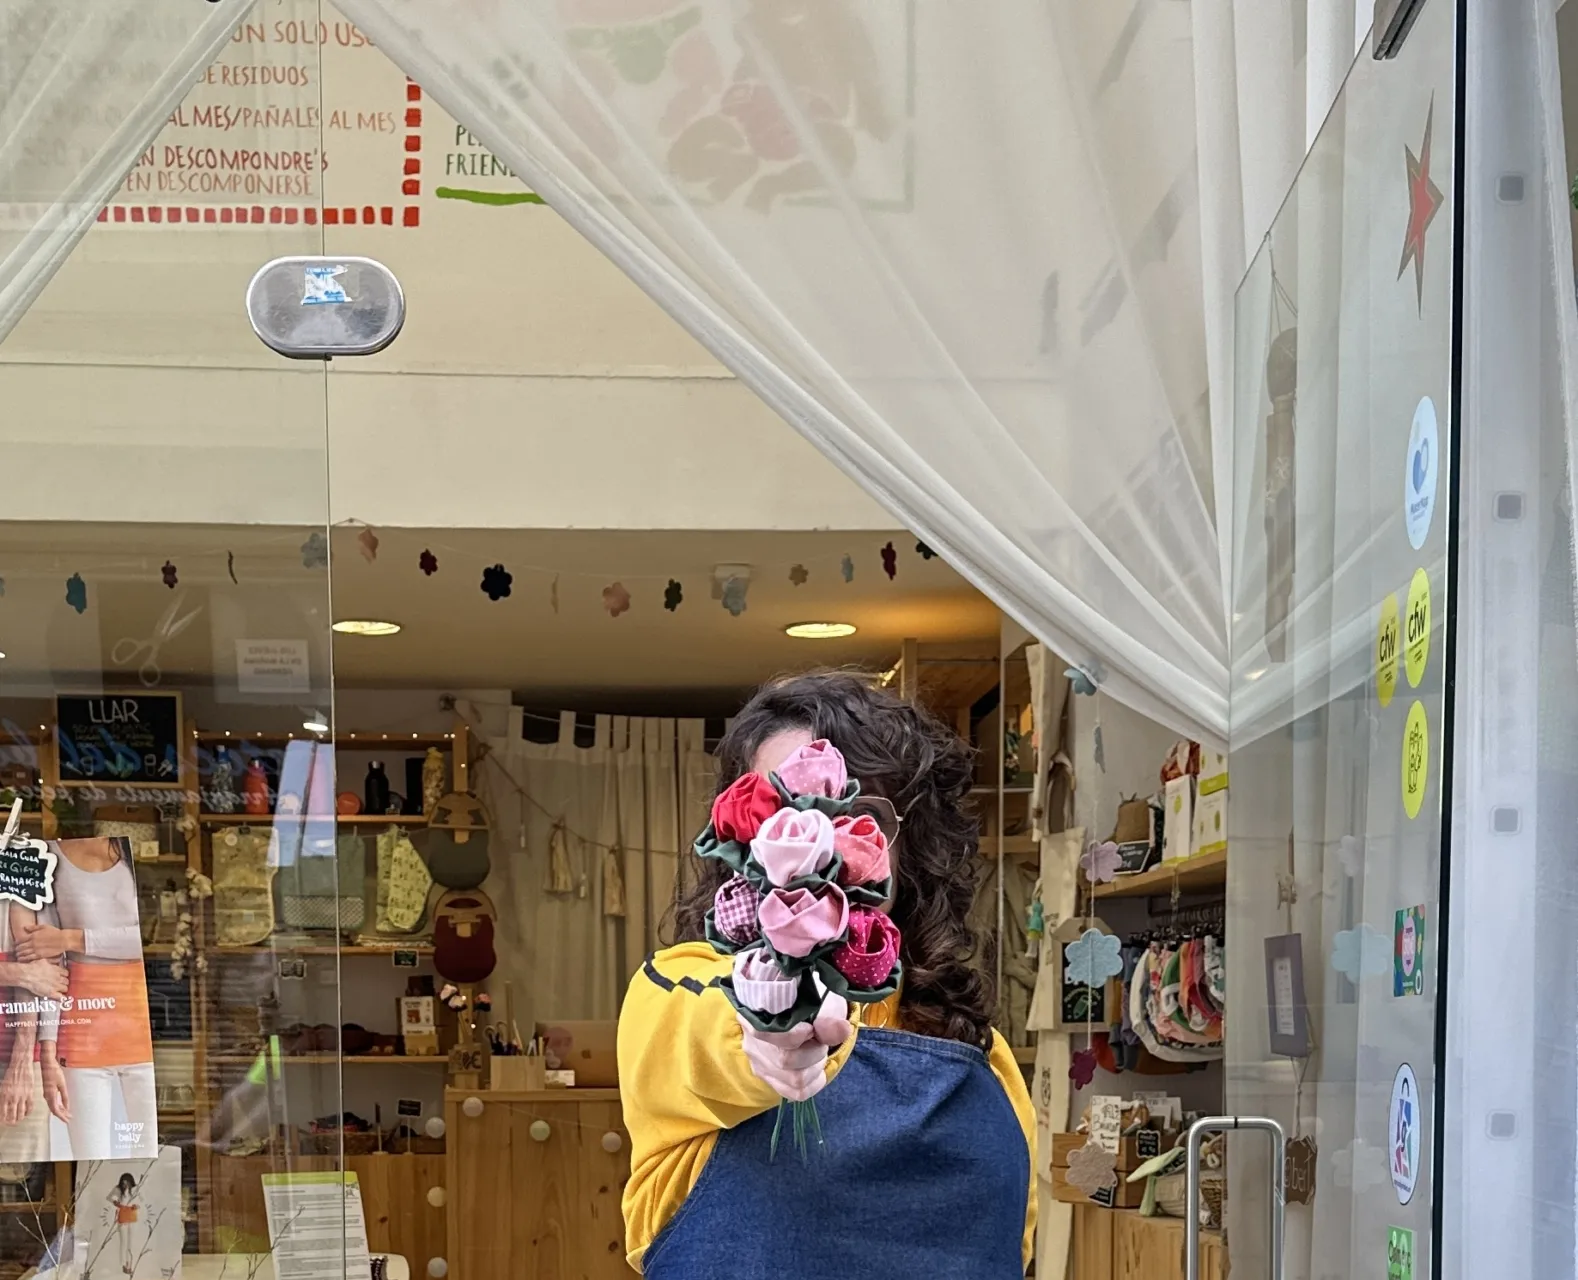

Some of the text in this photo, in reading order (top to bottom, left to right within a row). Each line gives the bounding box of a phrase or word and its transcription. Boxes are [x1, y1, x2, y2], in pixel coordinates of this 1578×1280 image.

[274, 20, 327, 44] SOLO
[221, 66, 309, 86] RESIDUOS
[329, 110, 352, 129] AL
[357, 111, 396, 133] MES
[126, 170, 314, 195] EN DESCOMPONERSE
[88, 699, 140, 724] LLAR
[60, 996, 74, 1011] &
[77, 996, 116, 1011] more
[114, 1122, 144, 1132] happy
[118, 1133, 142, 1143] belly
